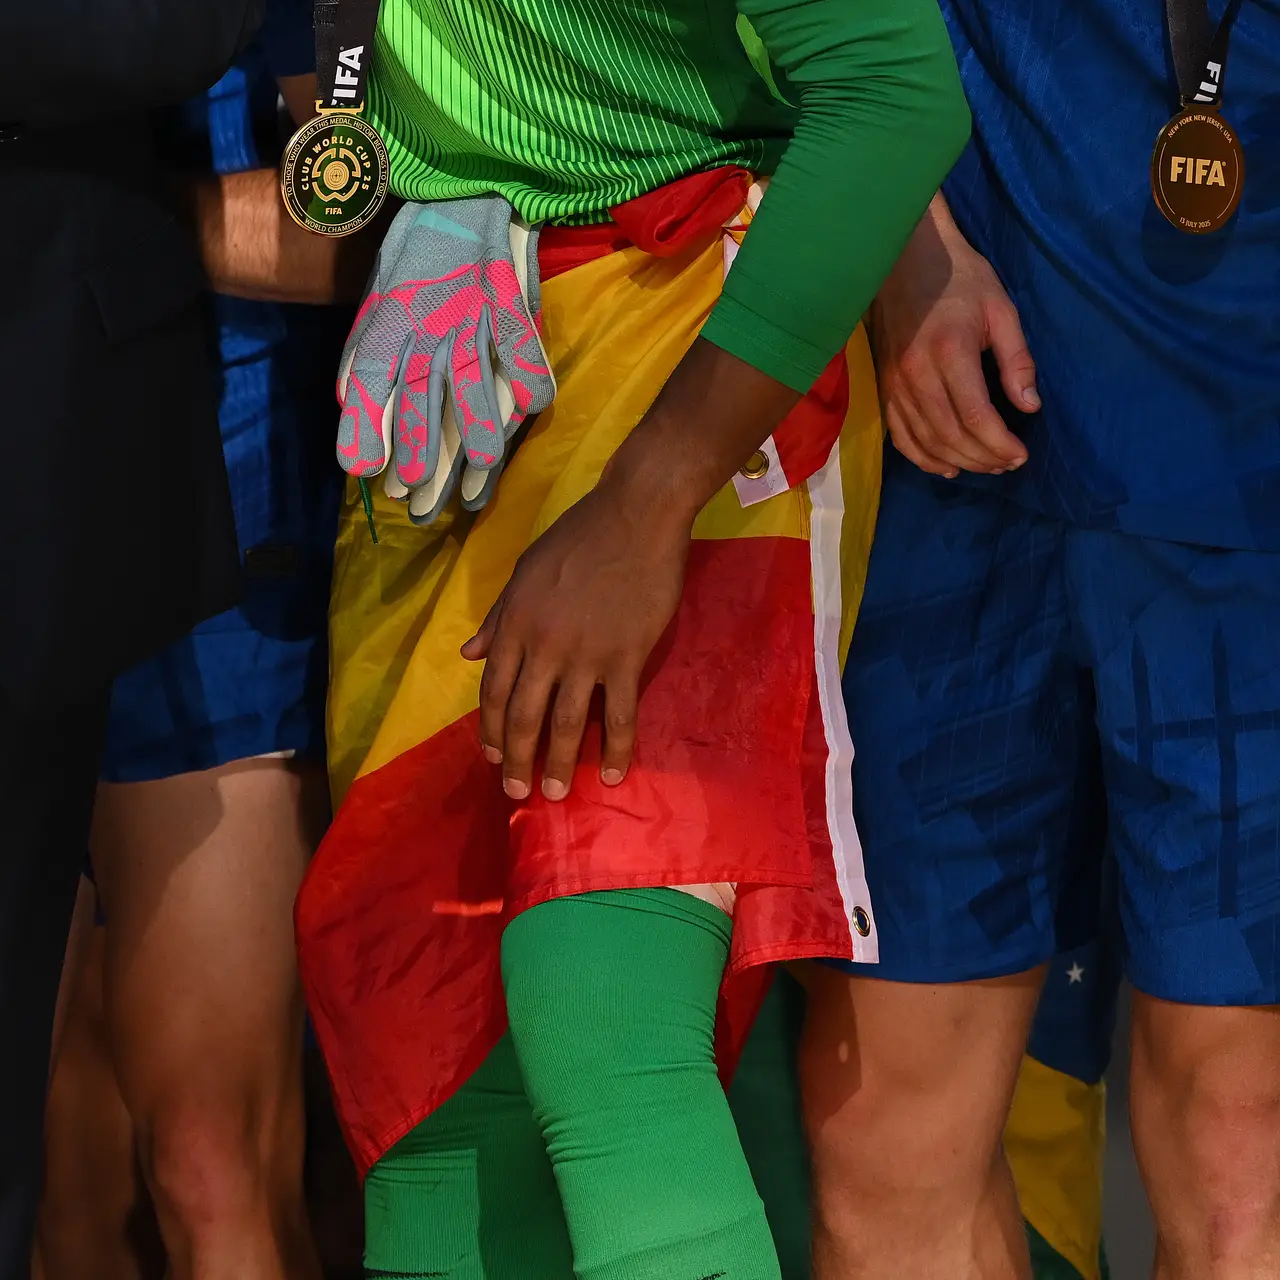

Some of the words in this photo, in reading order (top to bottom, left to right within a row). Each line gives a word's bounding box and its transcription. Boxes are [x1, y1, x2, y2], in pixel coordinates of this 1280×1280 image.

[315, 119, 329, 130] THIS
[329, 117, 352, 125] MEDAL,
[299, 128, 316, 145] WEAR
[353, 120, 376, 140] HISTORY
[1167, 125, 1179, 138] NEW
[1179, 116, 1193, 127] YORK
[1223, 130, 1233, 144] USA
[312, 135, 354, 154] WORLD
[289, 143, 301, 165] WHO
[356, 145, 371, 169] CUP
[373, 138, 387, 174] BELONGS
[285, 166, 293, 186] THOSE
[301, 156, 313, 191] CLUB
[380, 174, 387, 182] TO
[1170, 156, 1226, 187] FIFA
[361, 175, 372, 191] 25
[377, 182, 387, 198] YOU
[286, 187, 293, 197] TO
[325, 207, 343, 216] FIFA
[304, 217, 327, 232] WORLD
[327, 217, 363, 233] CHAMPION
[1185, 219, 1198, 228] JULY
